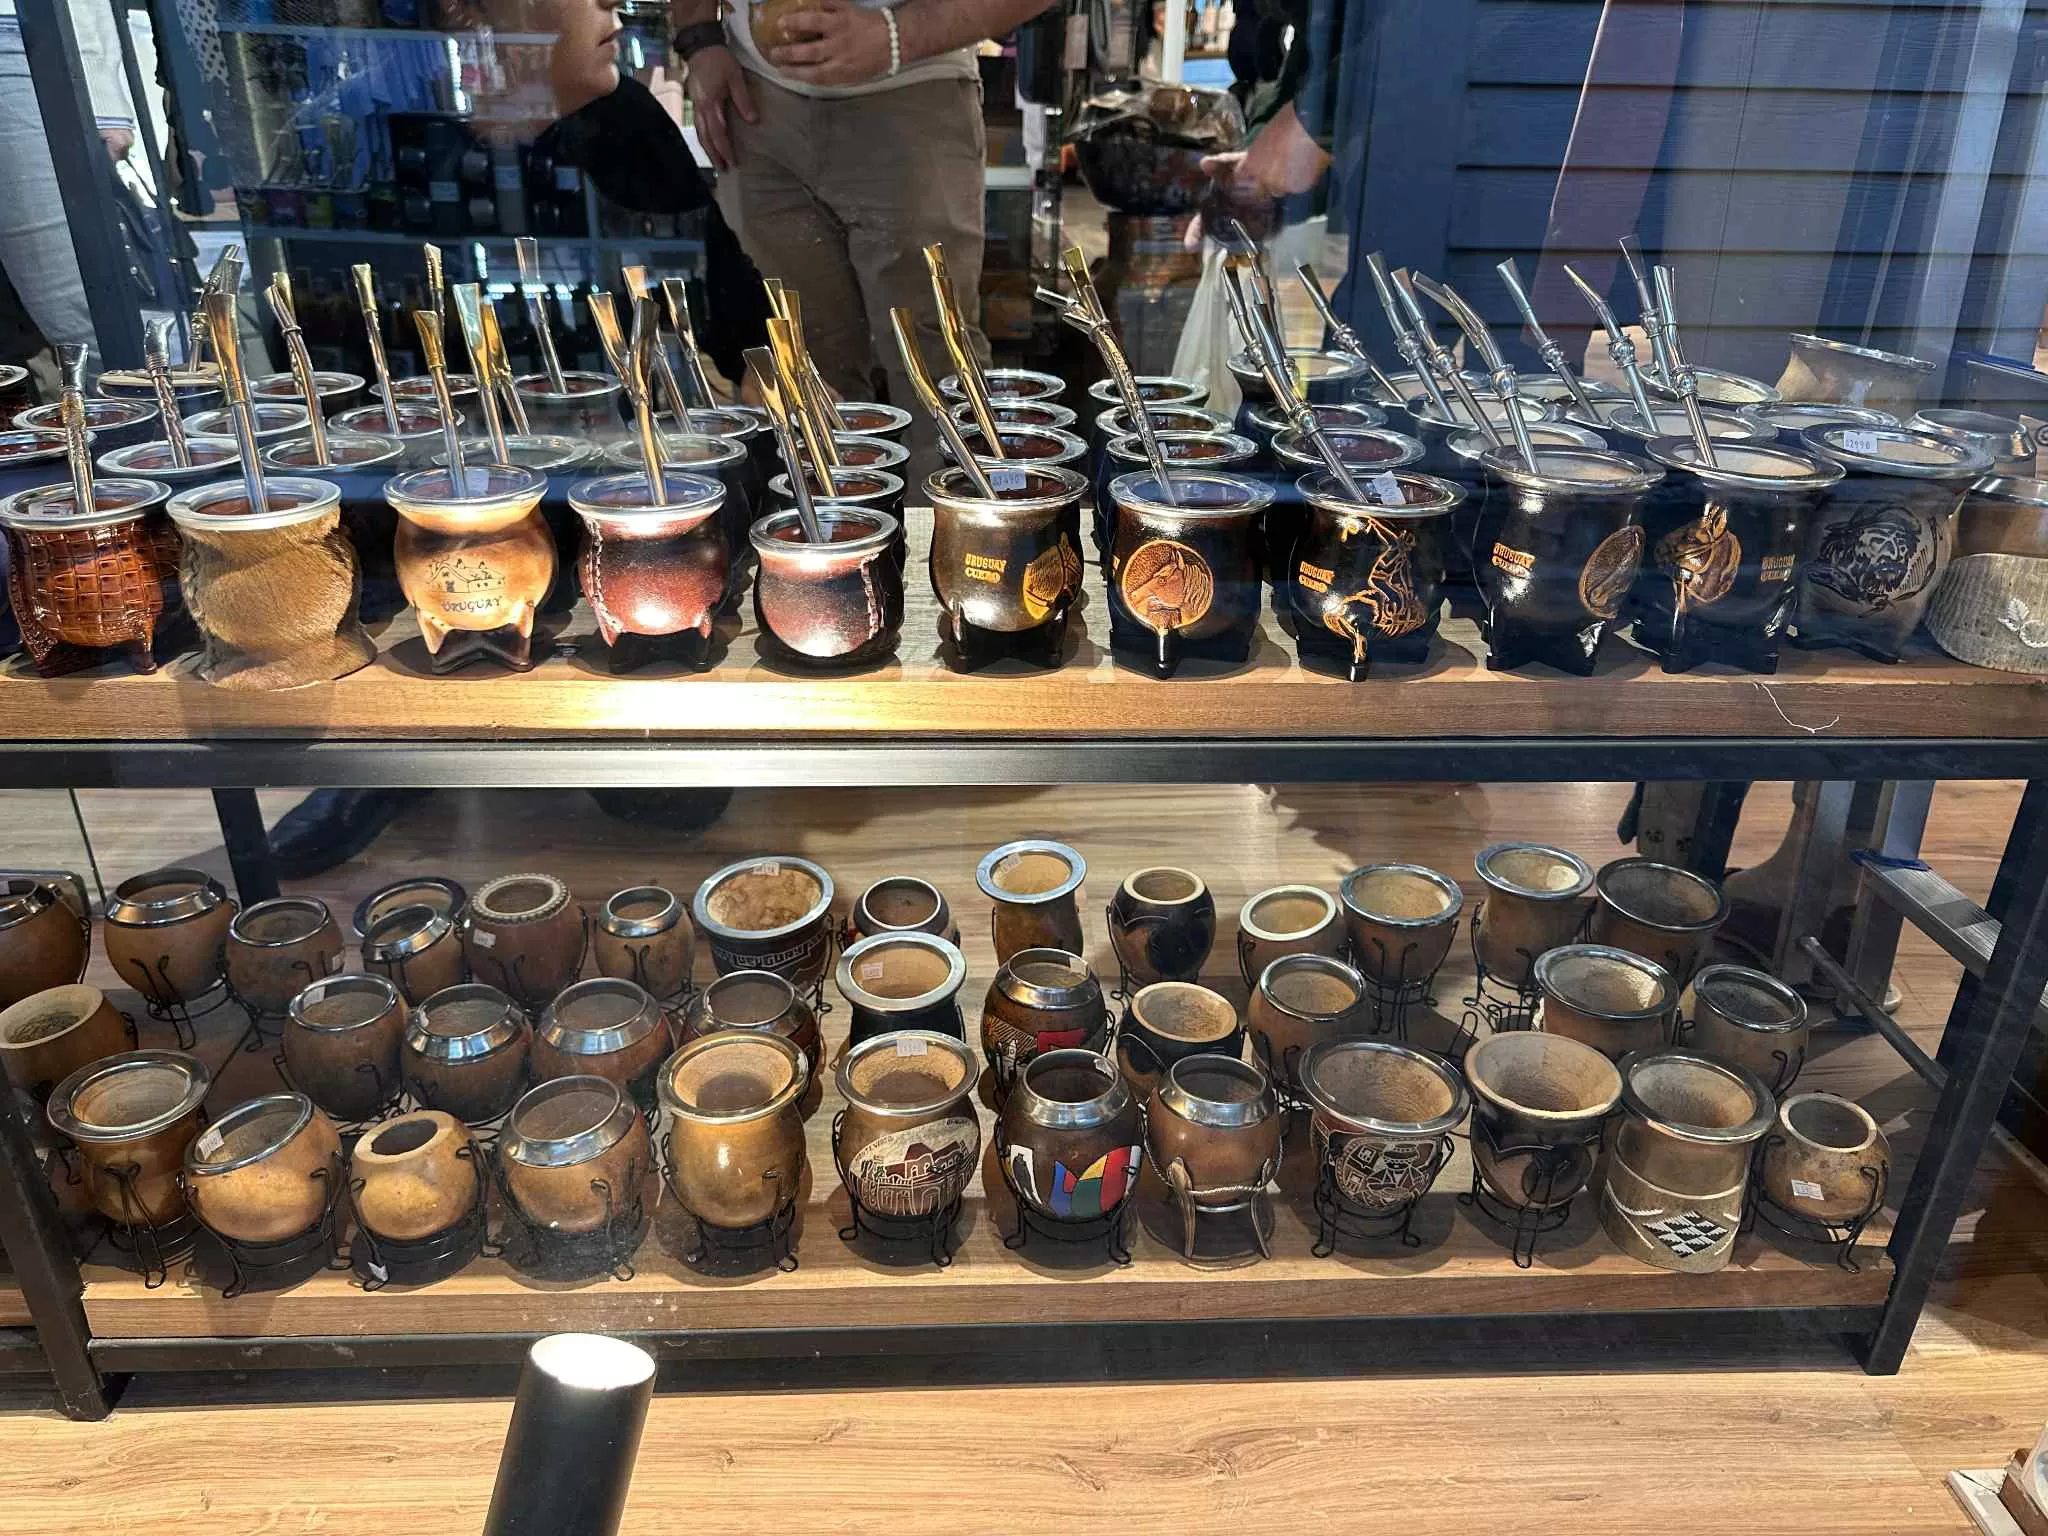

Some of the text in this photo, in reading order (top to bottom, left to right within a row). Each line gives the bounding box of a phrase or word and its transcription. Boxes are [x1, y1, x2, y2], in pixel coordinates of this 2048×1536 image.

[964, 553, 1007, 573] URUGUAY
[1493, 542, 1536, 570] URUGUAY
[440, 597, 502, 613] URUGUAY
